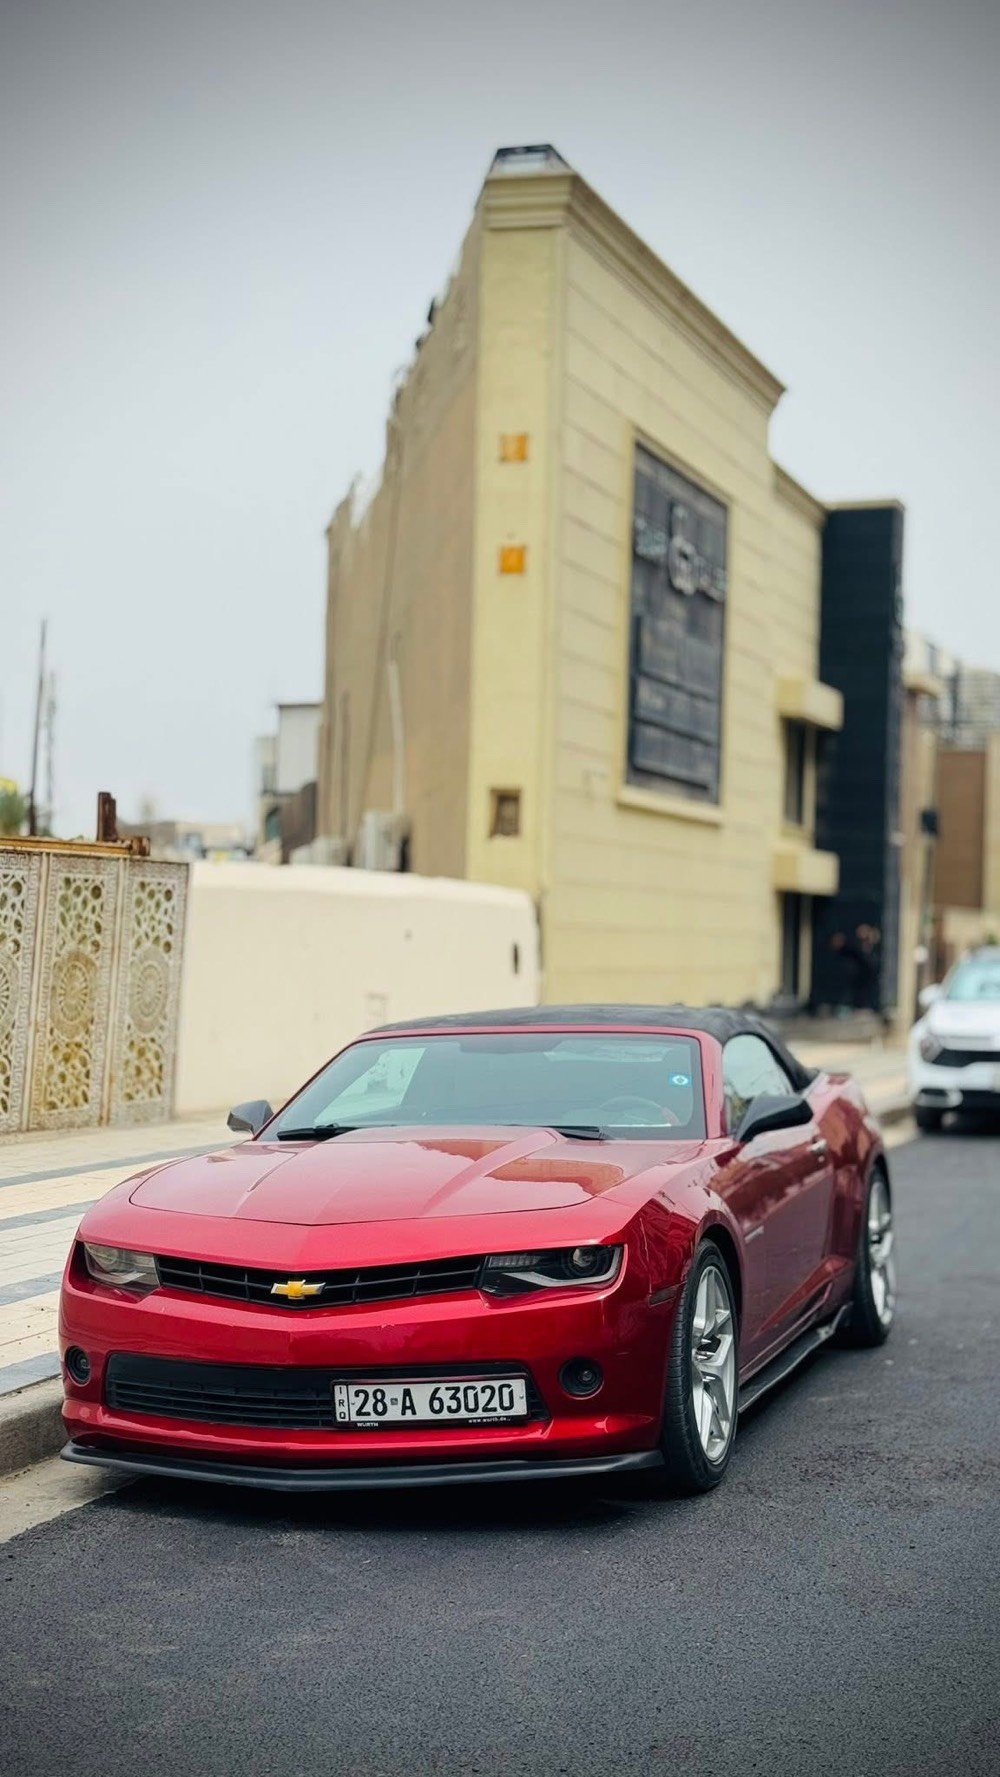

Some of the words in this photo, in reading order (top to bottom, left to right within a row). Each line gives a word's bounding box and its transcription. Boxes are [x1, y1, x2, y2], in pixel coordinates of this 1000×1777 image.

[354, 1388, 388, 1417] 28
[401, 1388, 417, 1416] A
[428, 1383, 515, 1415] 63020
